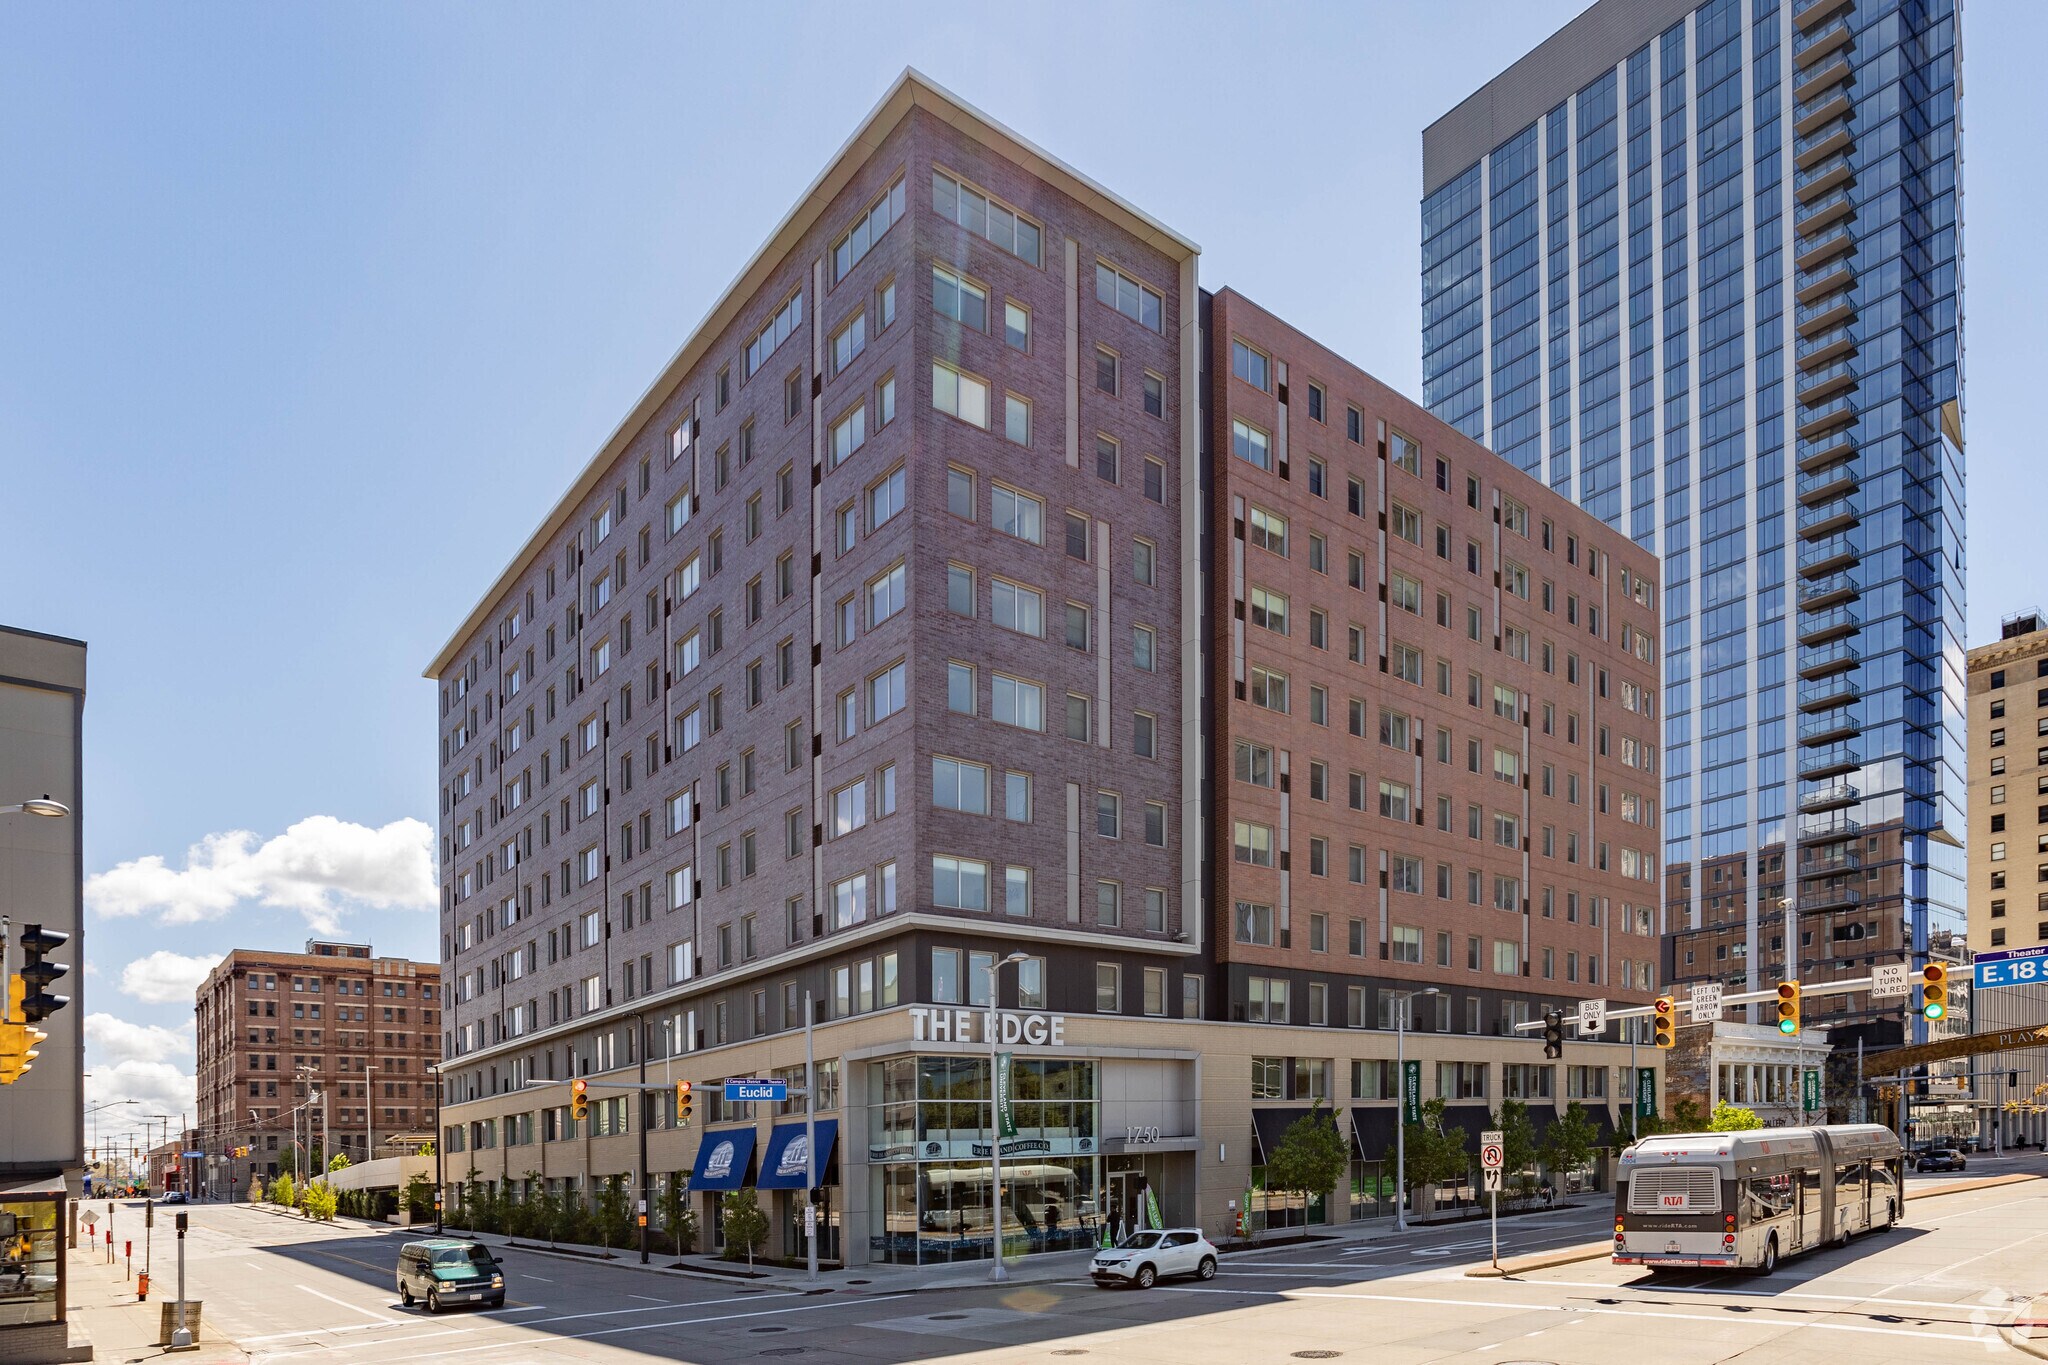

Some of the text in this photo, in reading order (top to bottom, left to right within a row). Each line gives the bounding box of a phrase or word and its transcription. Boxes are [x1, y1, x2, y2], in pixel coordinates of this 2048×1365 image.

[2007, 948, 2046, 958] Theater
[1983, 965, 2004, 983] E.
[2008, 961, 2037, 980] 18
[1879, 976, 1902, 985] TURN
[1693, 987, 1708, 996] LEFT
[1889, 985, 1907, 993] RED
[1696, 994, 1718, 1003] GREEN
[1584, 1002, 1600, 1011] BUS
[1695, 1003, 1719, 1012] ARROW
[1583, 1010, 1601, 1020] ONLY
[1698, 1011, 1715, 1019] ONLY
[909, 1008, 1065, 1046] THE EDGE
[739, 1086, 773, 1098] Euclid
[1125, 1126, 1160, 1144] 1750
[1482, 1133, 1502, 1142] TRUCK
[1014, 1142, 1038, 1151] COFFEE
[1663, 1196, 1683, 1206] RTA
